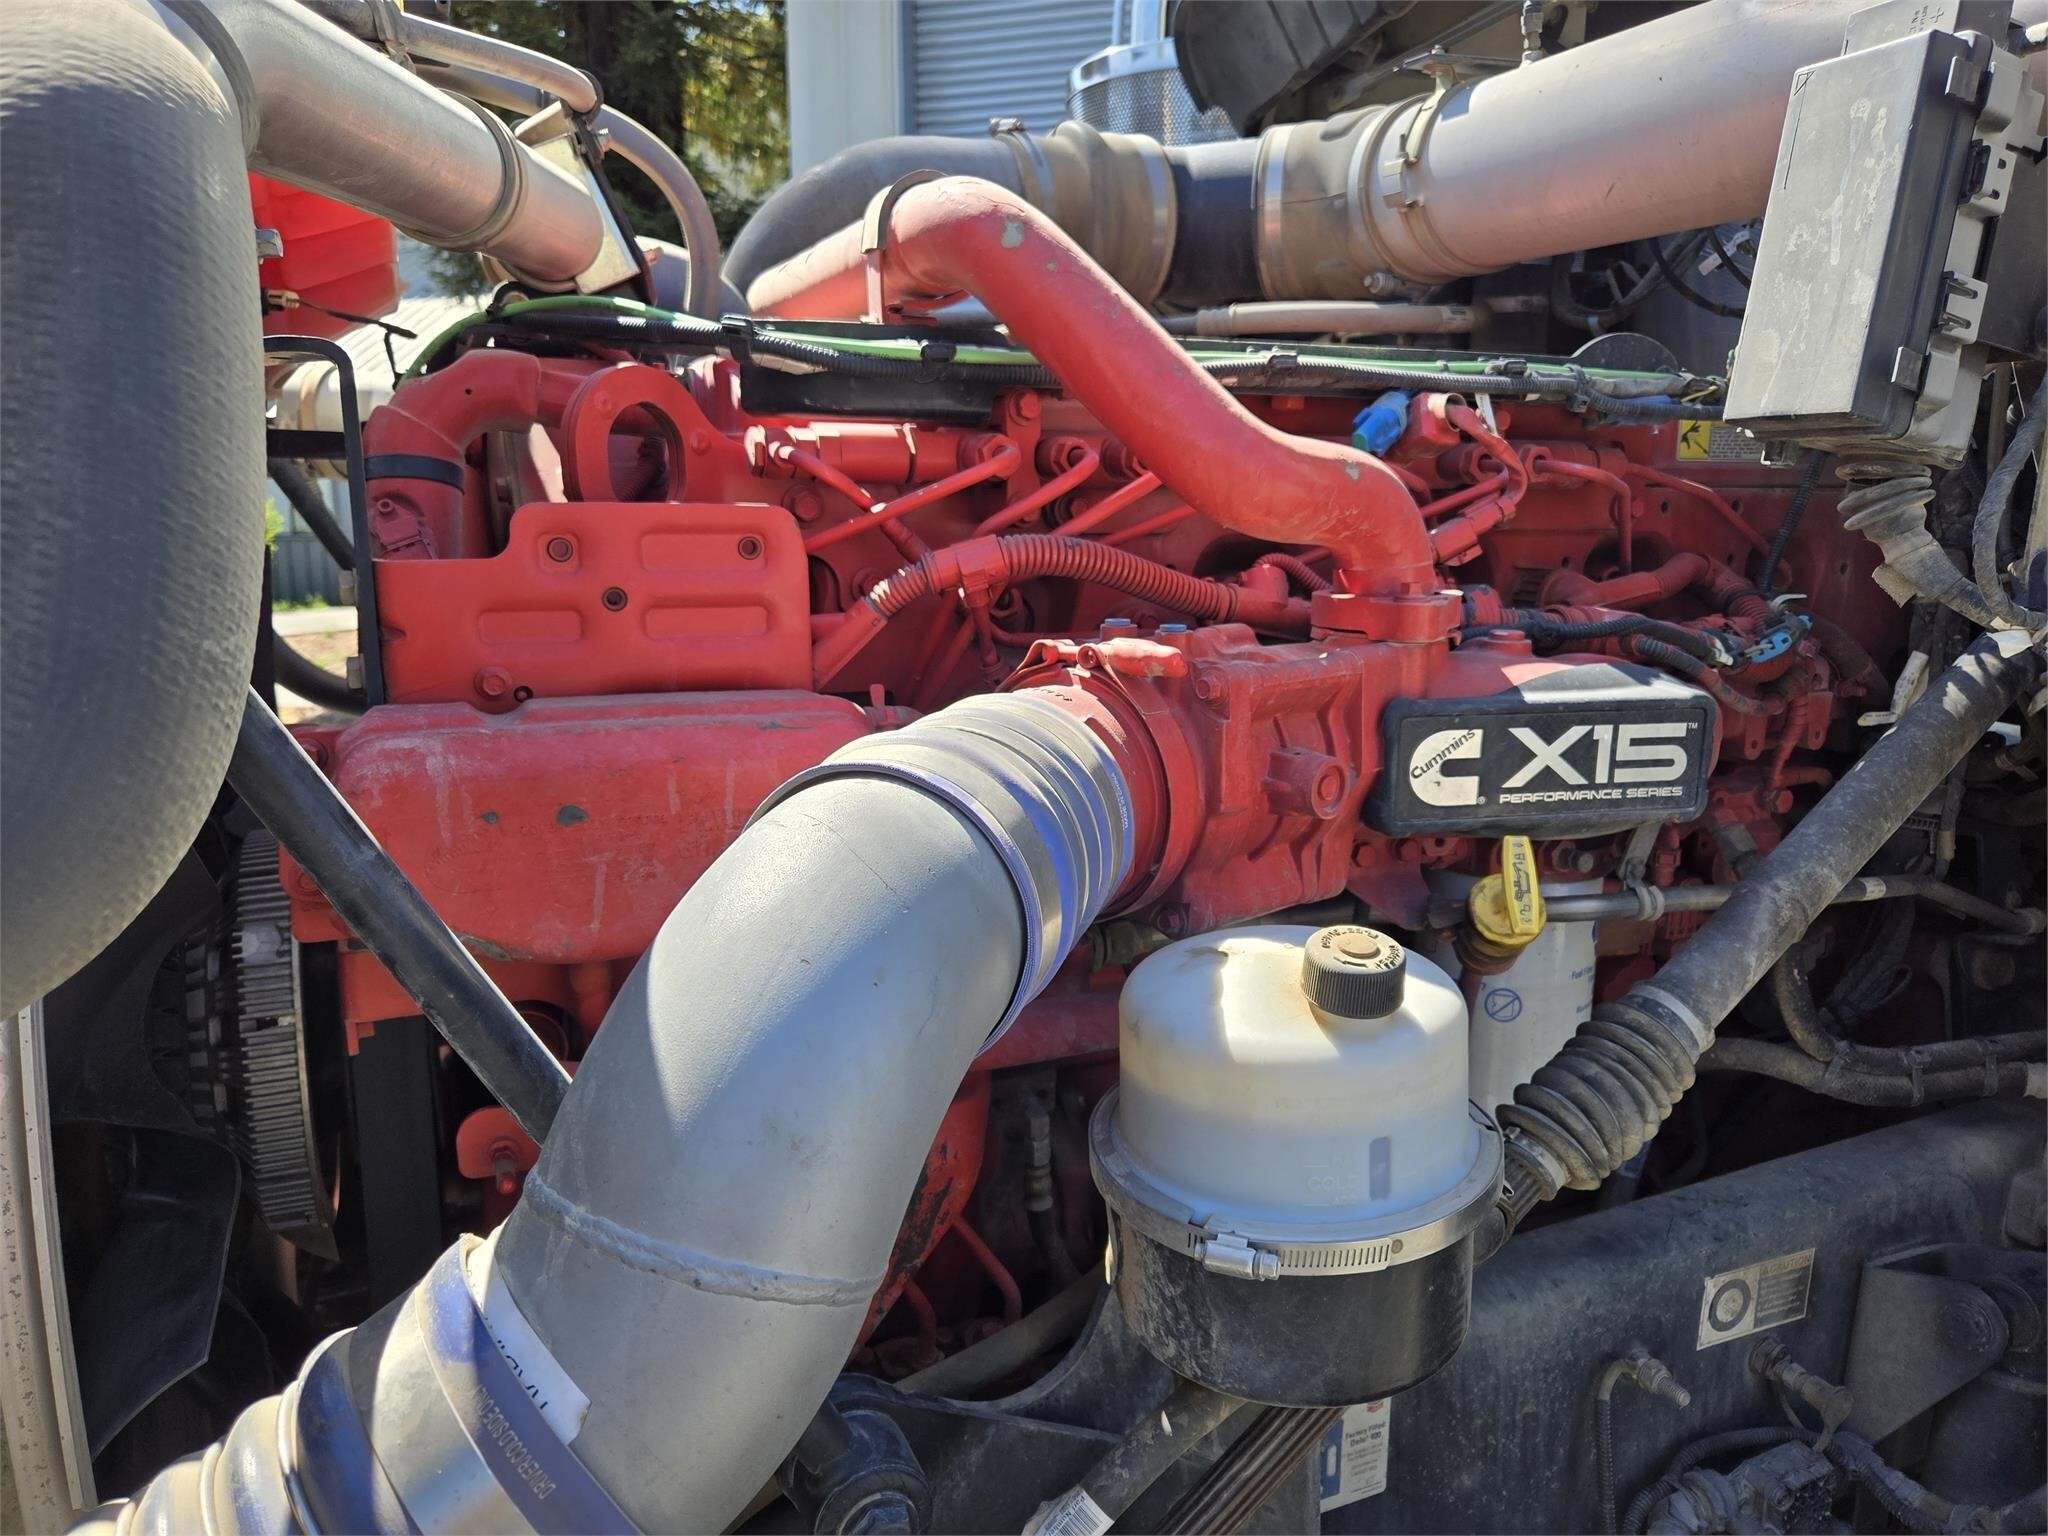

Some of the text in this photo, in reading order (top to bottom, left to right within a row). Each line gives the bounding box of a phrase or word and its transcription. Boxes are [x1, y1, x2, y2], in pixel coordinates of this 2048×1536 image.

[1411, 729, 1476, 780] Cummins
[1501, 722, 1688, 788] X15
[1499, 786, 1684, 804] PERFORMANCE SERIES
[483, 1406, 510, 1438] SIDE
[1071, 1495, 1086, 1511] Part
